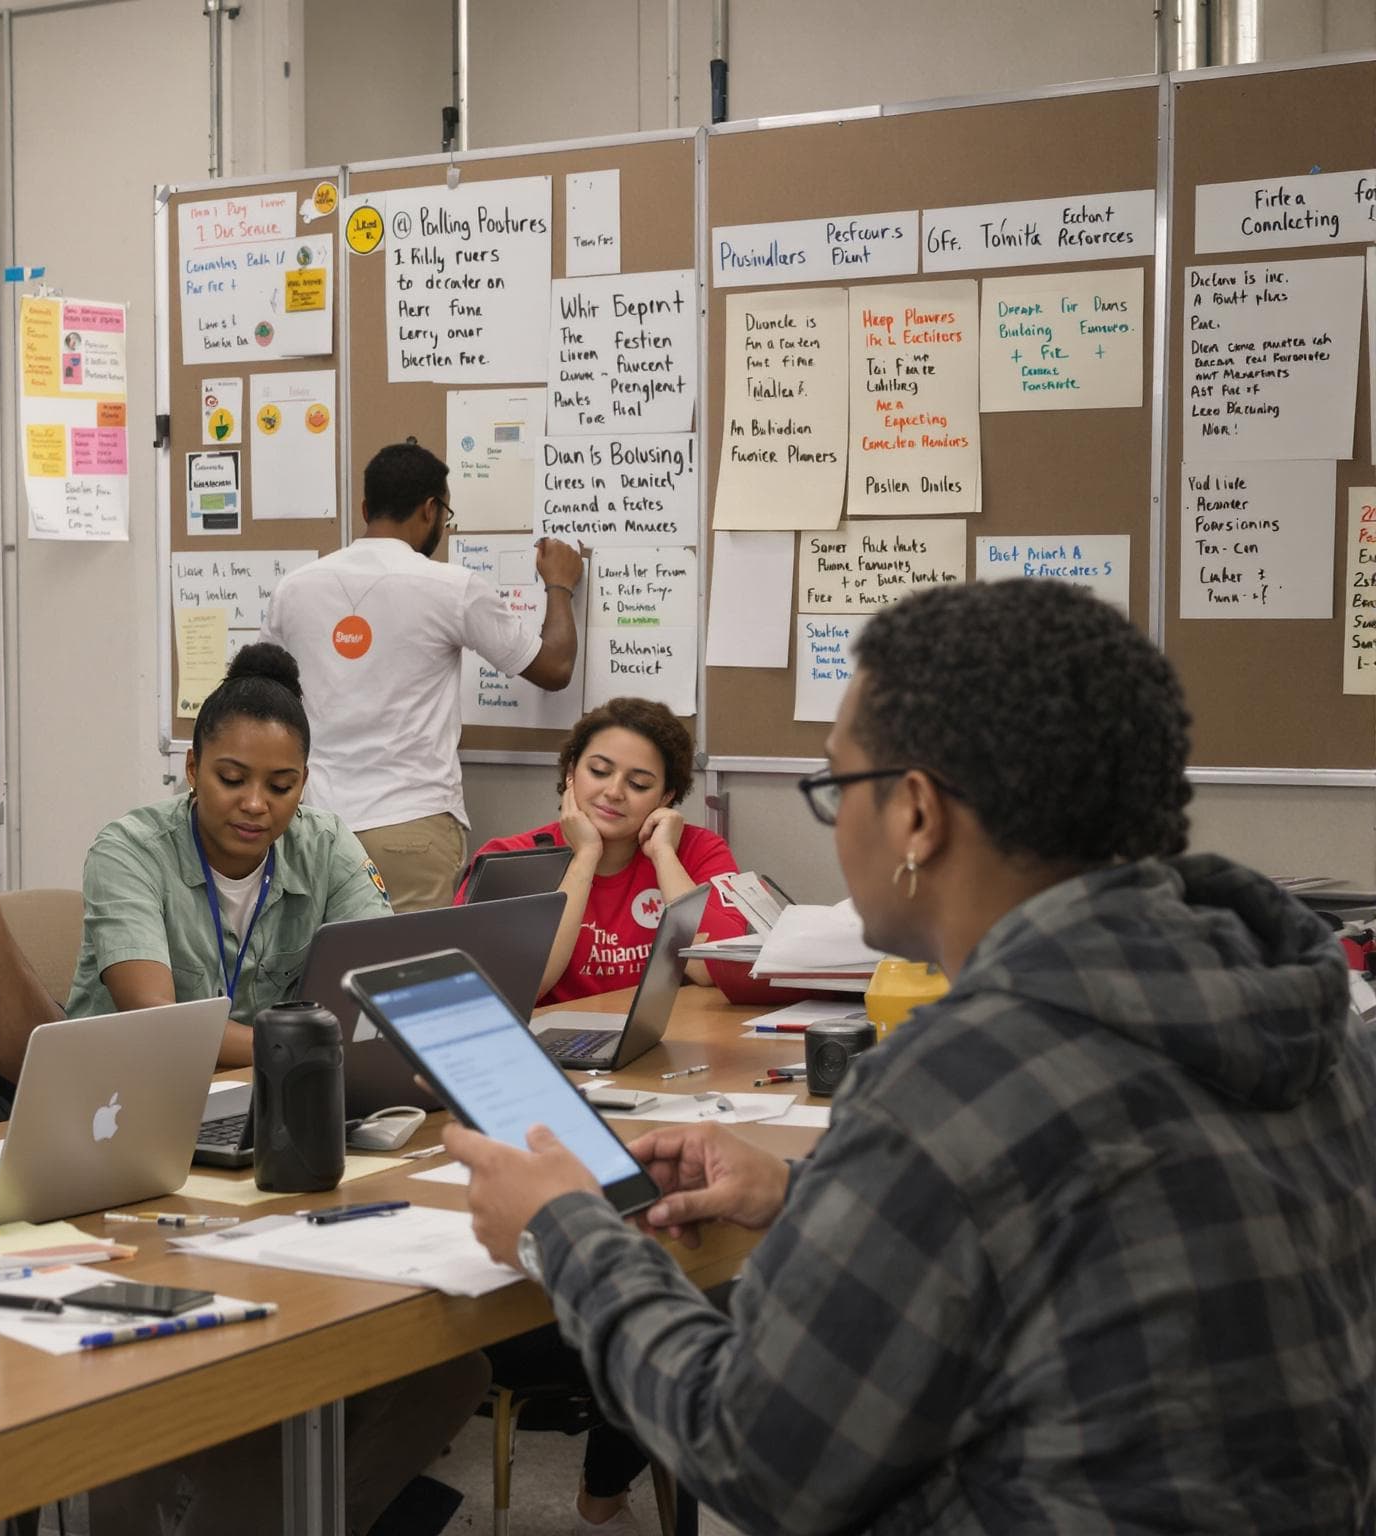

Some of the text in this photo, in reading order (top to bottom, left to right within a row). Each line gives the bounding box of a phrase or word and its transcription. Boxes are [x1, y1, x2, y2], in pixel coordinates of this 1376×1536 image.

[396, 273, 413, 291] to
[487, 277, 505, 289] on
[559, 326, 585, 345] The
[607, 501, 617, 512] a
